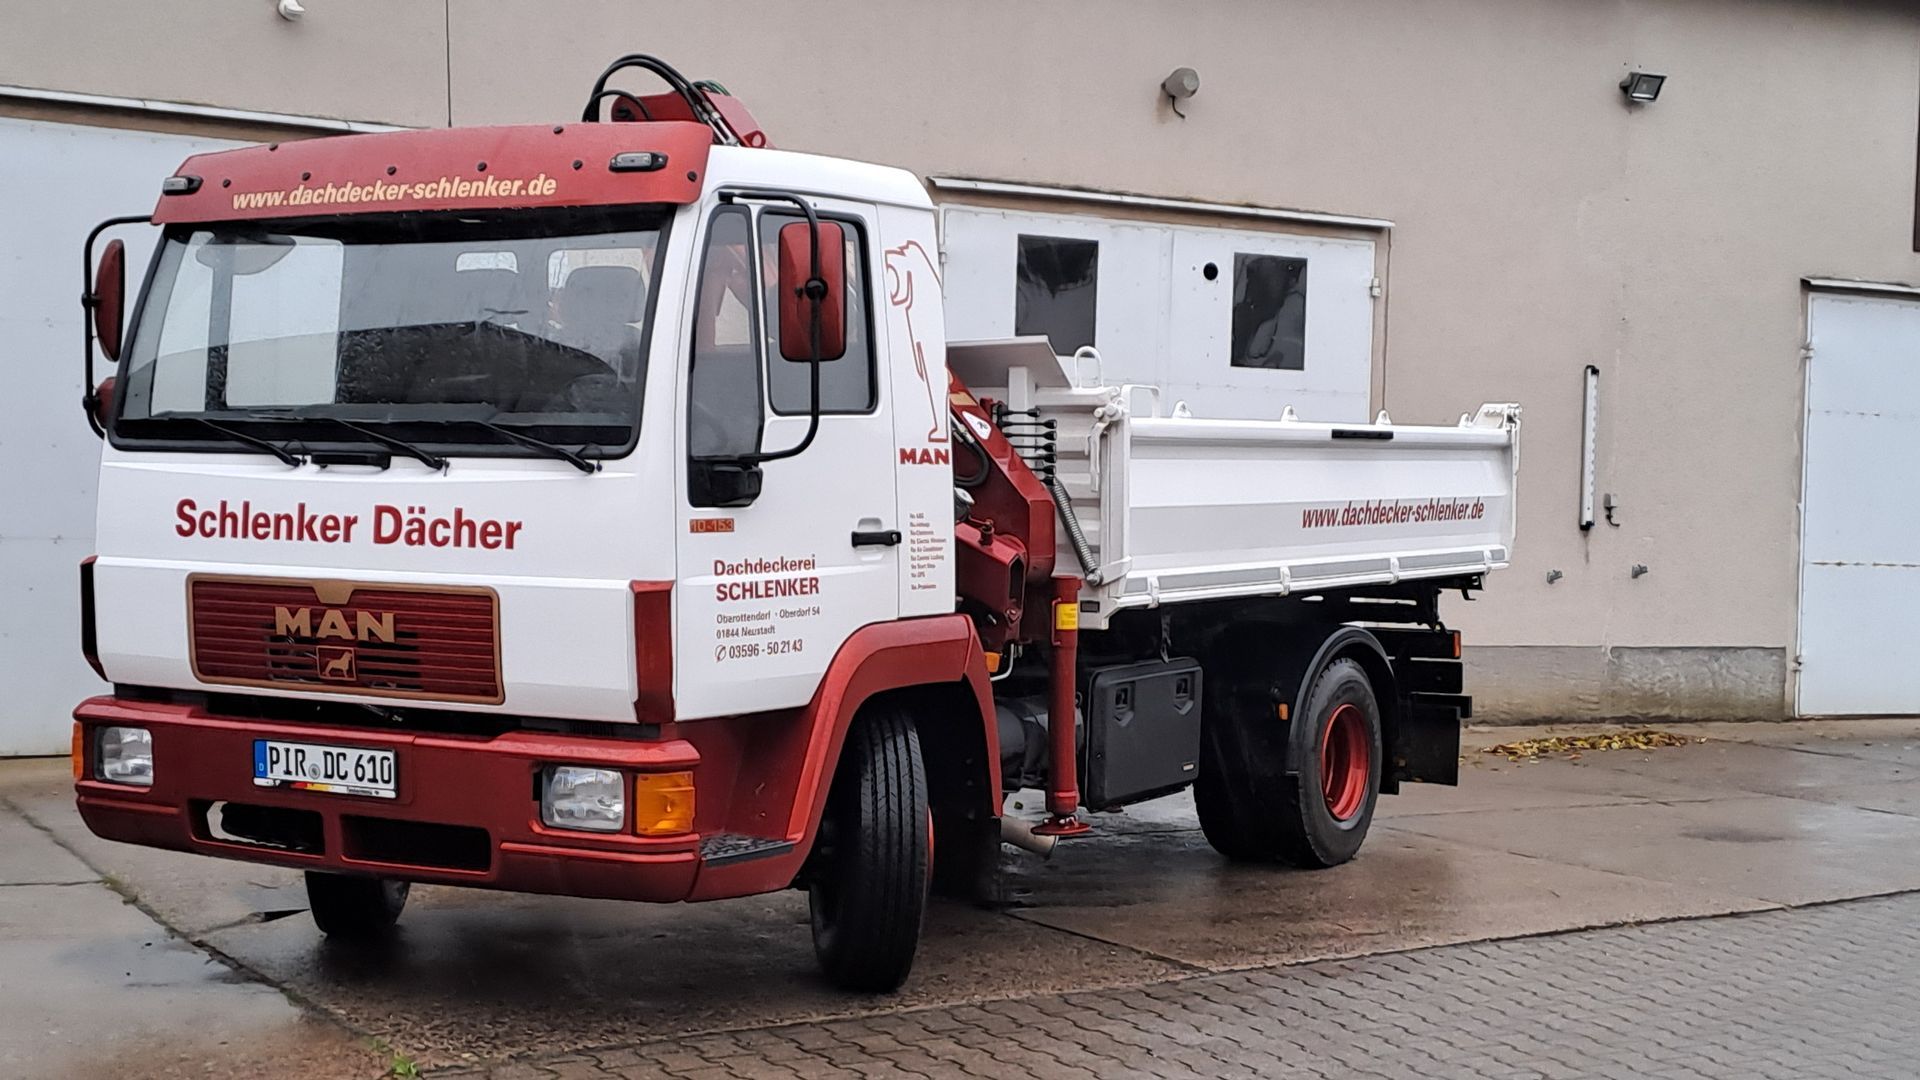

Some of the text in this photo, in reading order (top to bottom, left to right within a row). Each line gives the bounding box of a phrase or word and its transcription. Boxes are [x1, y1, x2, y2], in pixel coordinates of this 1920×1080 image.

[231, 173, 558, 210] www.dachdecker-schlenker.de
[900, 448, 950, 465] MAN
[175, 498, 522, 550] Schlenker Dächer
[1302, 496, 1485, 529] www.dachdecker-schlenker.de
[714, 554, 816, 576] Dachdeckerei
[716, 577, 820, 602] SCHLENKER
[274, 605, 398, 643] MAN
[716, 610, 771, 625] Oberottendorf
[779, 606, 811, 619] Oberdorf
[716, 625, 776, 640] 01844 Neustadt
[729, 643, 760, 659] 03596
[268, 745, 307, 777] PIR
[323, 750, 349, 780] DC
[354, 753, 392, 785] 610
